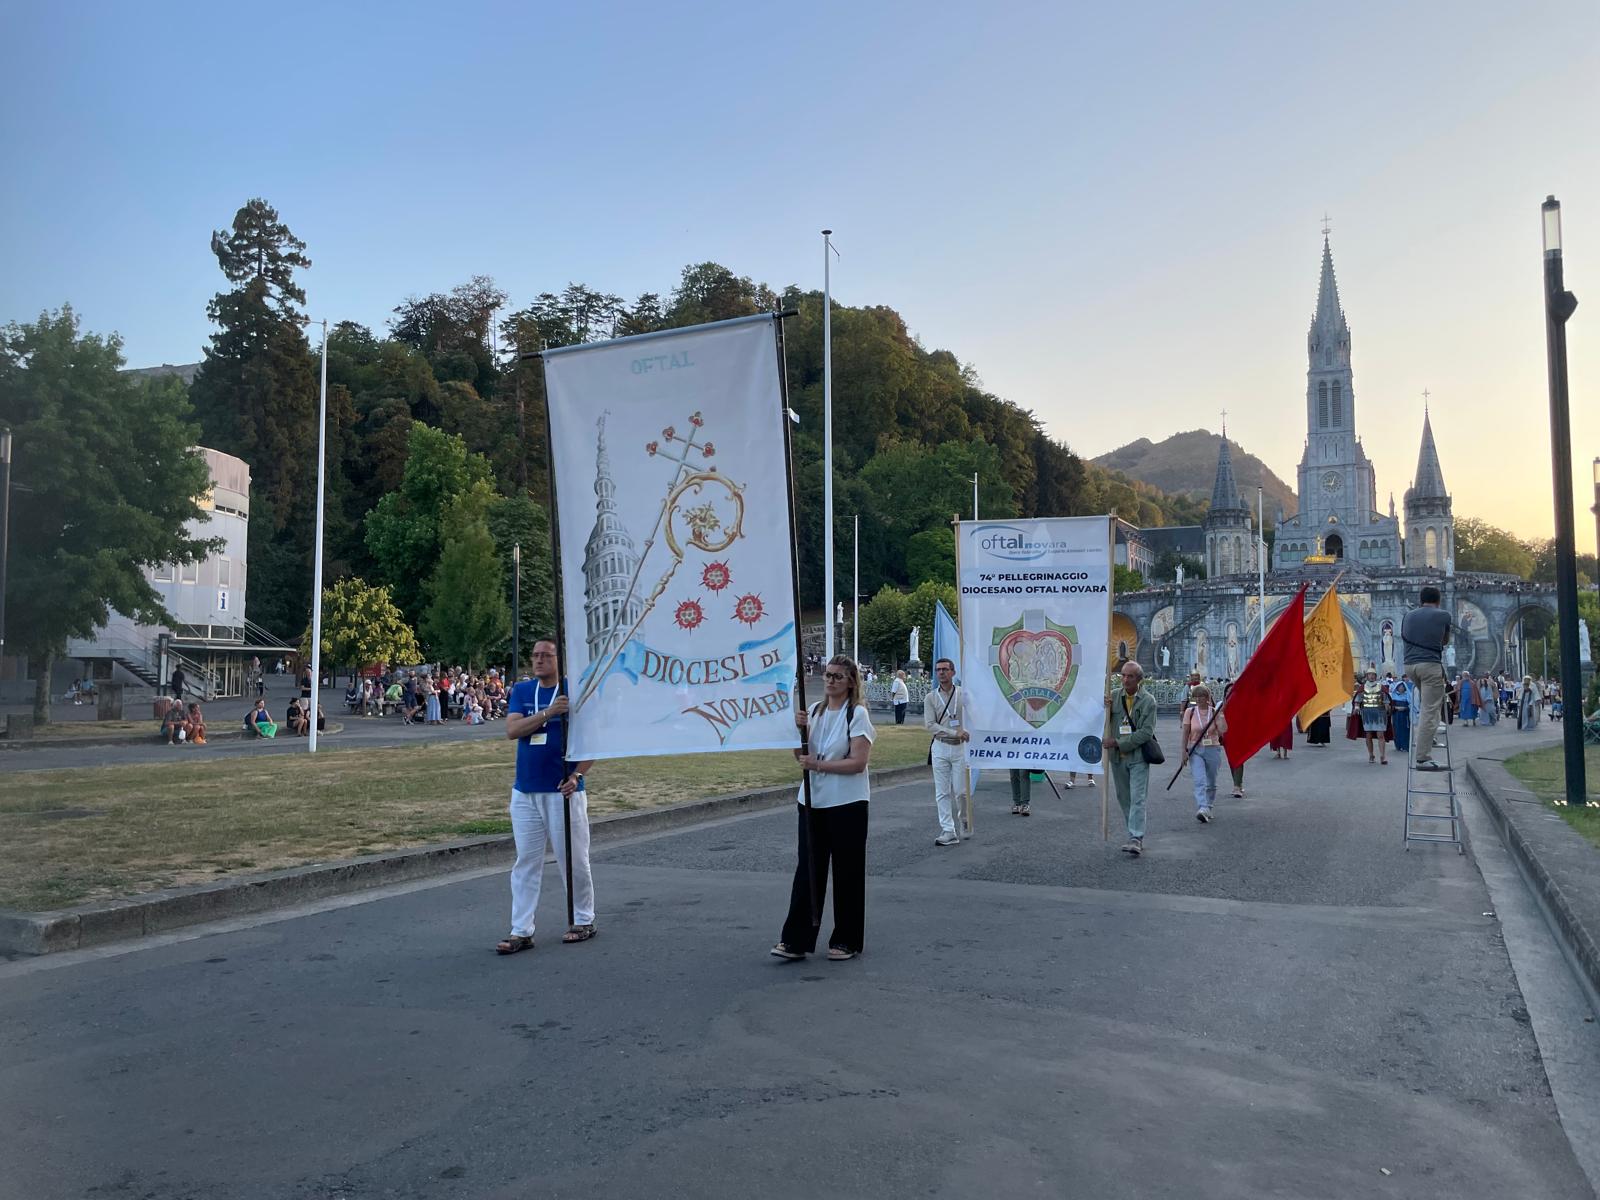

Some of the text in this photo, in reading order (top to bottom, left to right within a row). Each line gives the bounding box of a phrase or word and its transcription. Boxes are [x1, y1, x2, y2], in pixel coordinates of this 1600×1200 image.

[631, 351, 695, 376] OFTAL
[998, 572, 1088, 581] PELLEGRINAGGIO
[962, 585, 1108, 594] DIOCESANO OFTAL NOVARA
[641, 648, 782, 686] DIOCESI DI
[983, 735, 1052, 745] AVE MARIA
[1006, 751, 1019, 759] DI
[1024, 751, 1070, 761] GRAZIA
